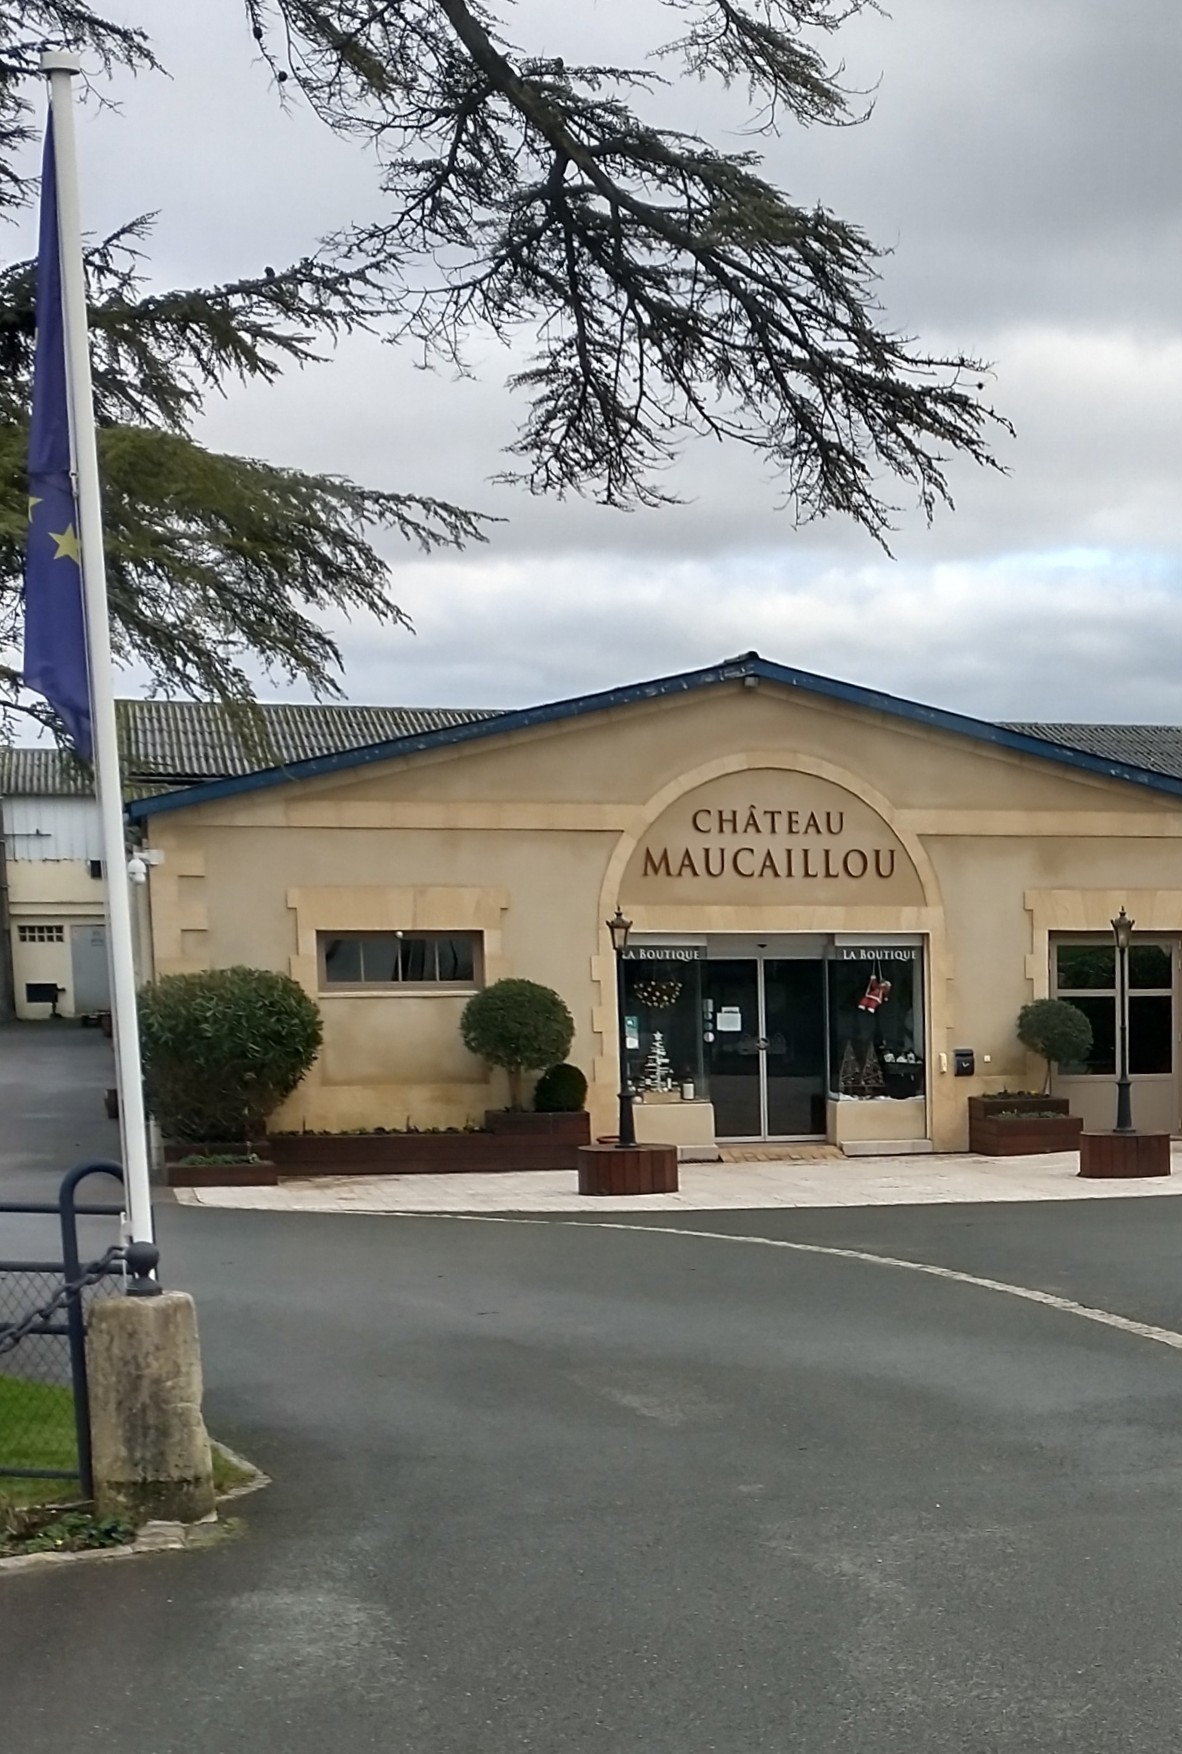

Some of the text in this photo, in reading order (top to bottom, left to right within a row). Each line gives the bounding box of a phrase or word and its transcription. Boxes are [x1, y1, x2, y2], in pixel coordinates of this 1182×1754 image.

[692, 804, 845, 835] CHÂTEAU
[642, 846, 897, 879] MAUCAILLOU
[639, 948, 700, 962] BOUTIQUE
[843, 948, 917, 962] LA BOUTIQUE
